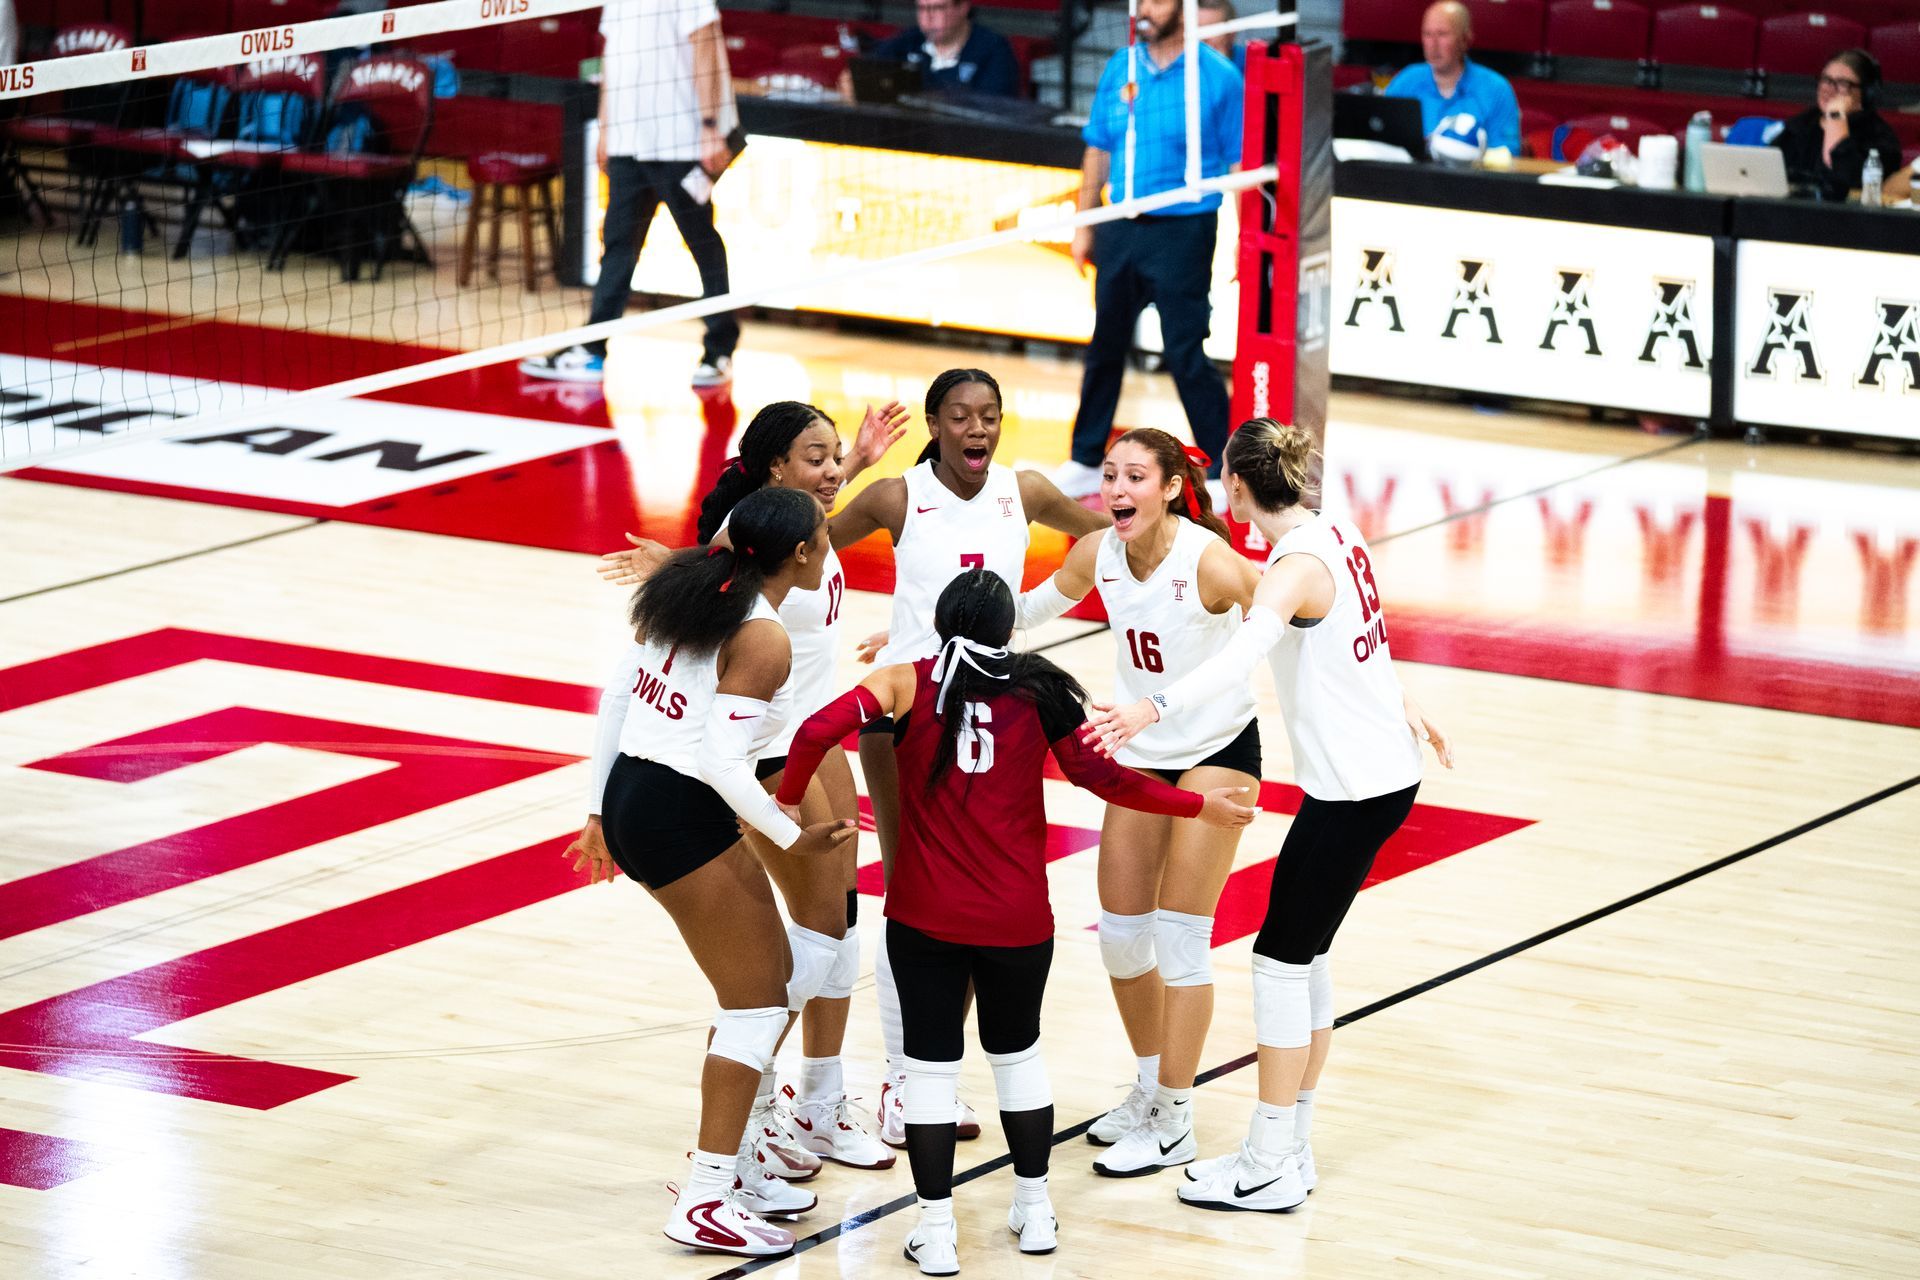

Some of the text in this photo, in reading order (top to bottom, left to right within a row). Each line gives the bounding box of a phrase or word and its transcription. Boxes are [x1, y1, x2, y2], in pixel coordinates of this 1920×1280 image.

[241, 28, 294, 56] OWLS
[481, 0, 528, 18] OWLS
[351, 62, 425, 92] TEMPLE
[998, 497, 1014, 518] T
[825, 571, 842, 627] 17
[1172, 579, 1187, 601] T
[1346, 545, 1381, 624] 13
[1126, 628, 1164, 674] 16
[1353, 618, 1388, 663] OWL
[957, 701, 994, 773] 6
